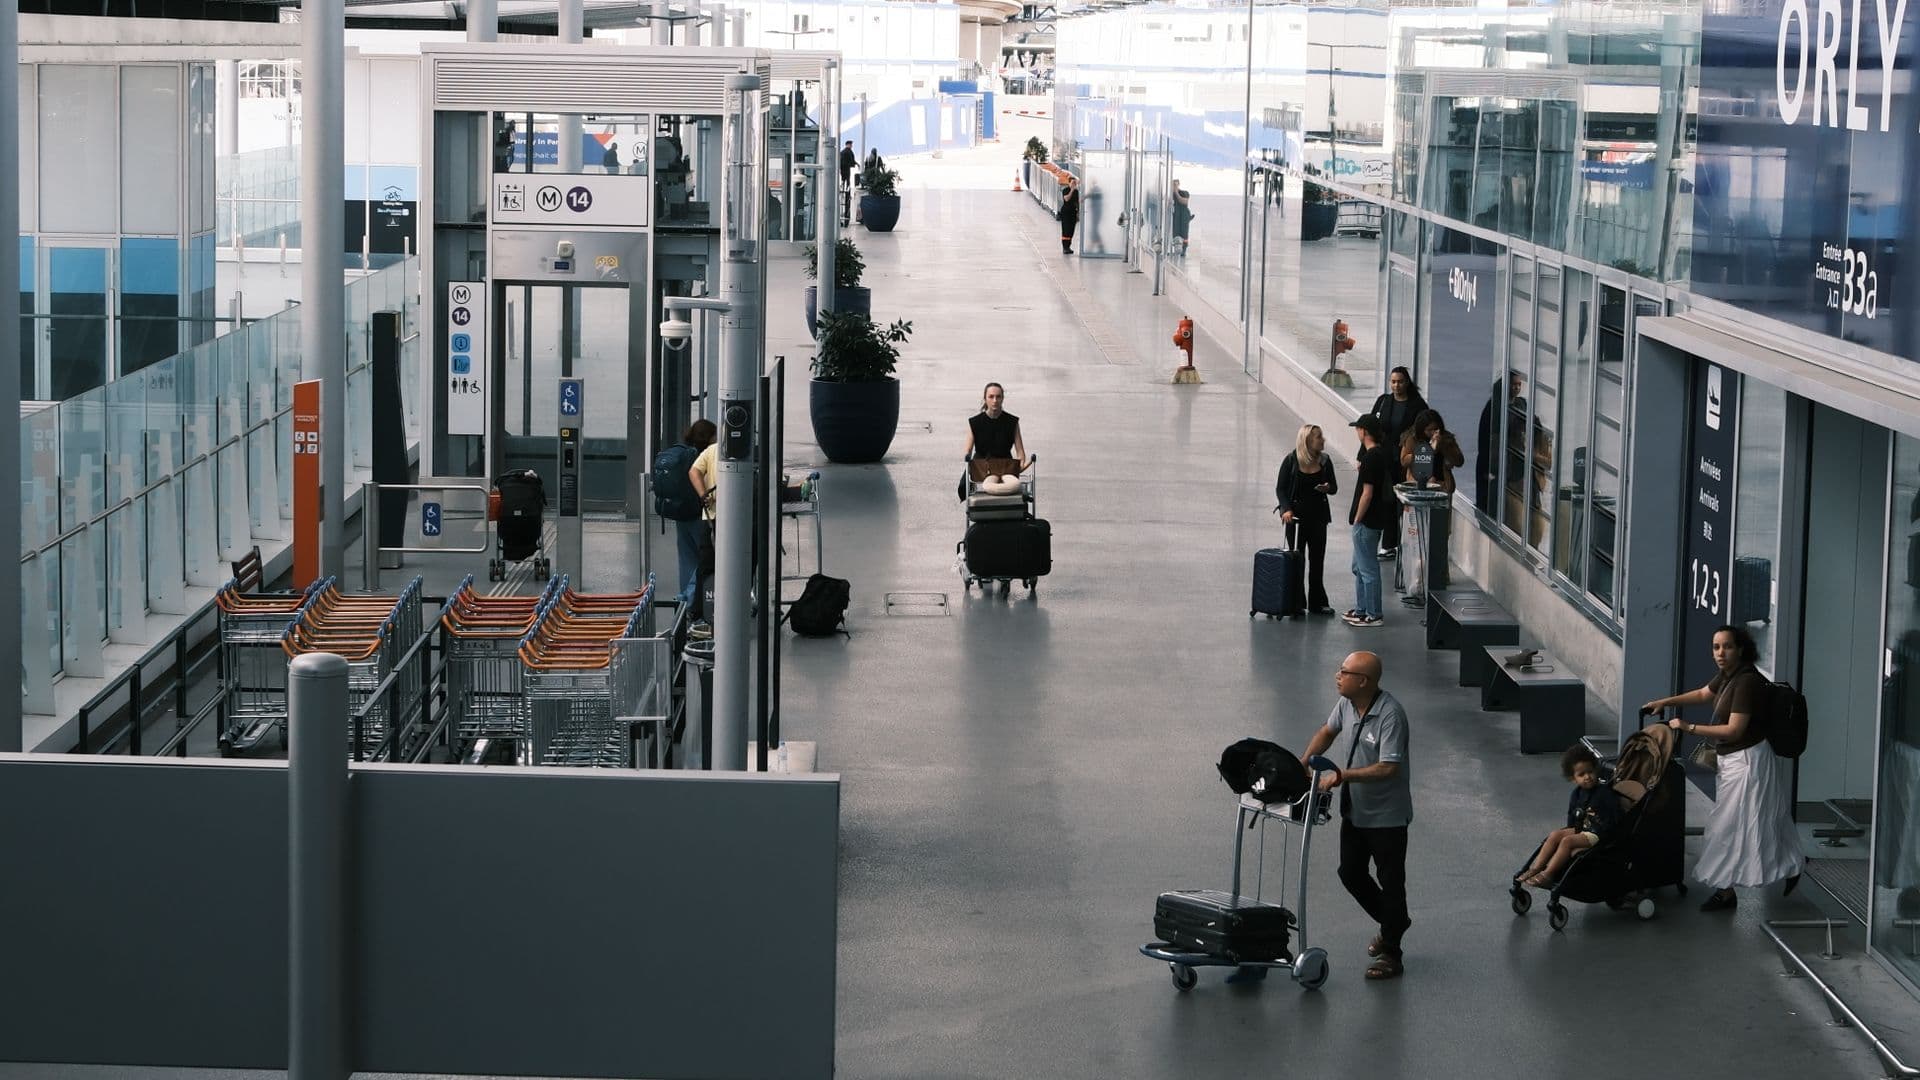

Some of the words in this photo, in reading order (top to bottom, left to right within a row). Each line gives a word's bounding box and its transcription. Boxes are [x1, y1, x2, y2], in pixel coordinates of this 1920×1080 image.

[1776, 0, 1907, 132] ORLY
[569, 191, 590, 207] 14
[1822, 241, 1842, 262] Entrée
[1815, 261, 1841, 284] Entrance
[1841, 248, 1878, 320] B3a
[1459, 271, 1473, 312] Orly
[1472, 275, 1477, 308] 4
[1826, 287, 1840, 310] 入口
[453, 310, 469, 322] 14
[1700, 455, 1721, 482] Arrivées
[1699, 487, 1720, 513] Arrivals
